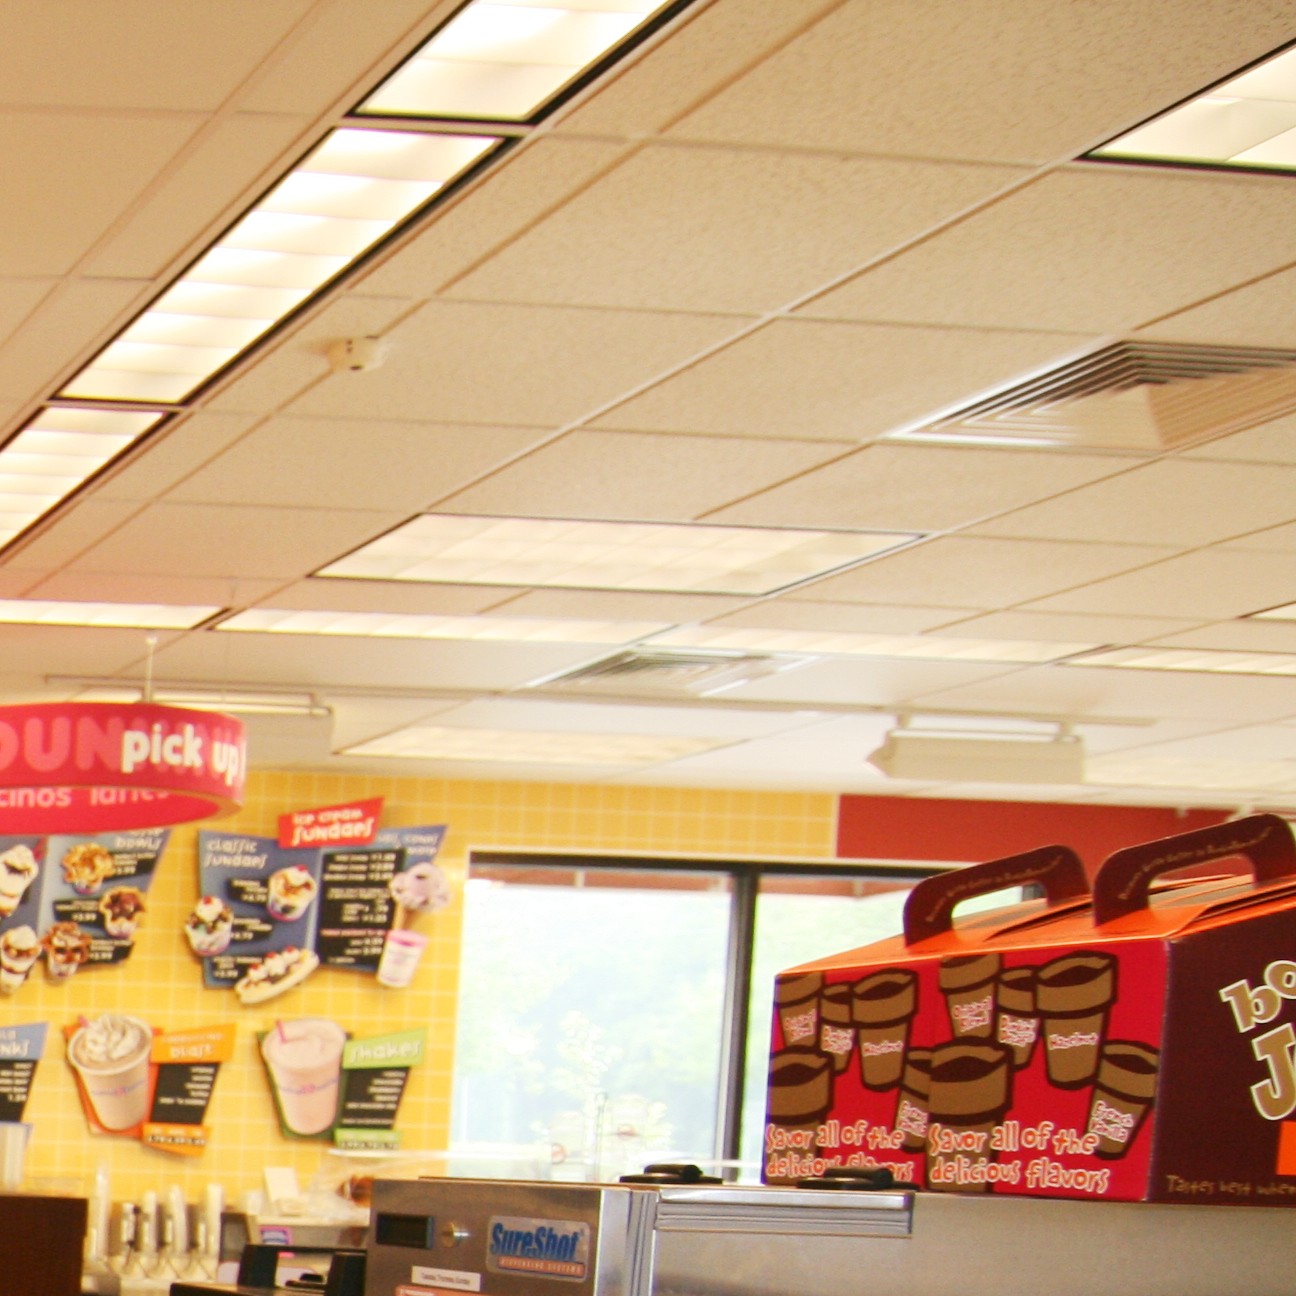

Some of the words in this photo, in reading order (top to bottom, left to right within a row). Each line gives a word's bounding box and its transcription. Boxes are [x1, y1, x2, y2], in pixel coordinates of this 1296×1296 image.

[121, 724, 204, 773] pick
[213, 741, 243, 785] up
[1219, 959, 1296, 1034] bo
[815, 1119, 840, 1148] all
[840, 1119, 868, 1147] of
[867, 1125, 906, 1150] the
[928, 1122, 988, 1157] Savor
[990, 1120, 1020, 1152] all
[1020, 1120, 1054, 1150] of
[1052, 1128, 1100, 1155] the
[929, 1154, 1022, 1185] delicious
[1024, 1155, 1111, 1195] flavors
[490, 1222, 581, 1262] SureShot
